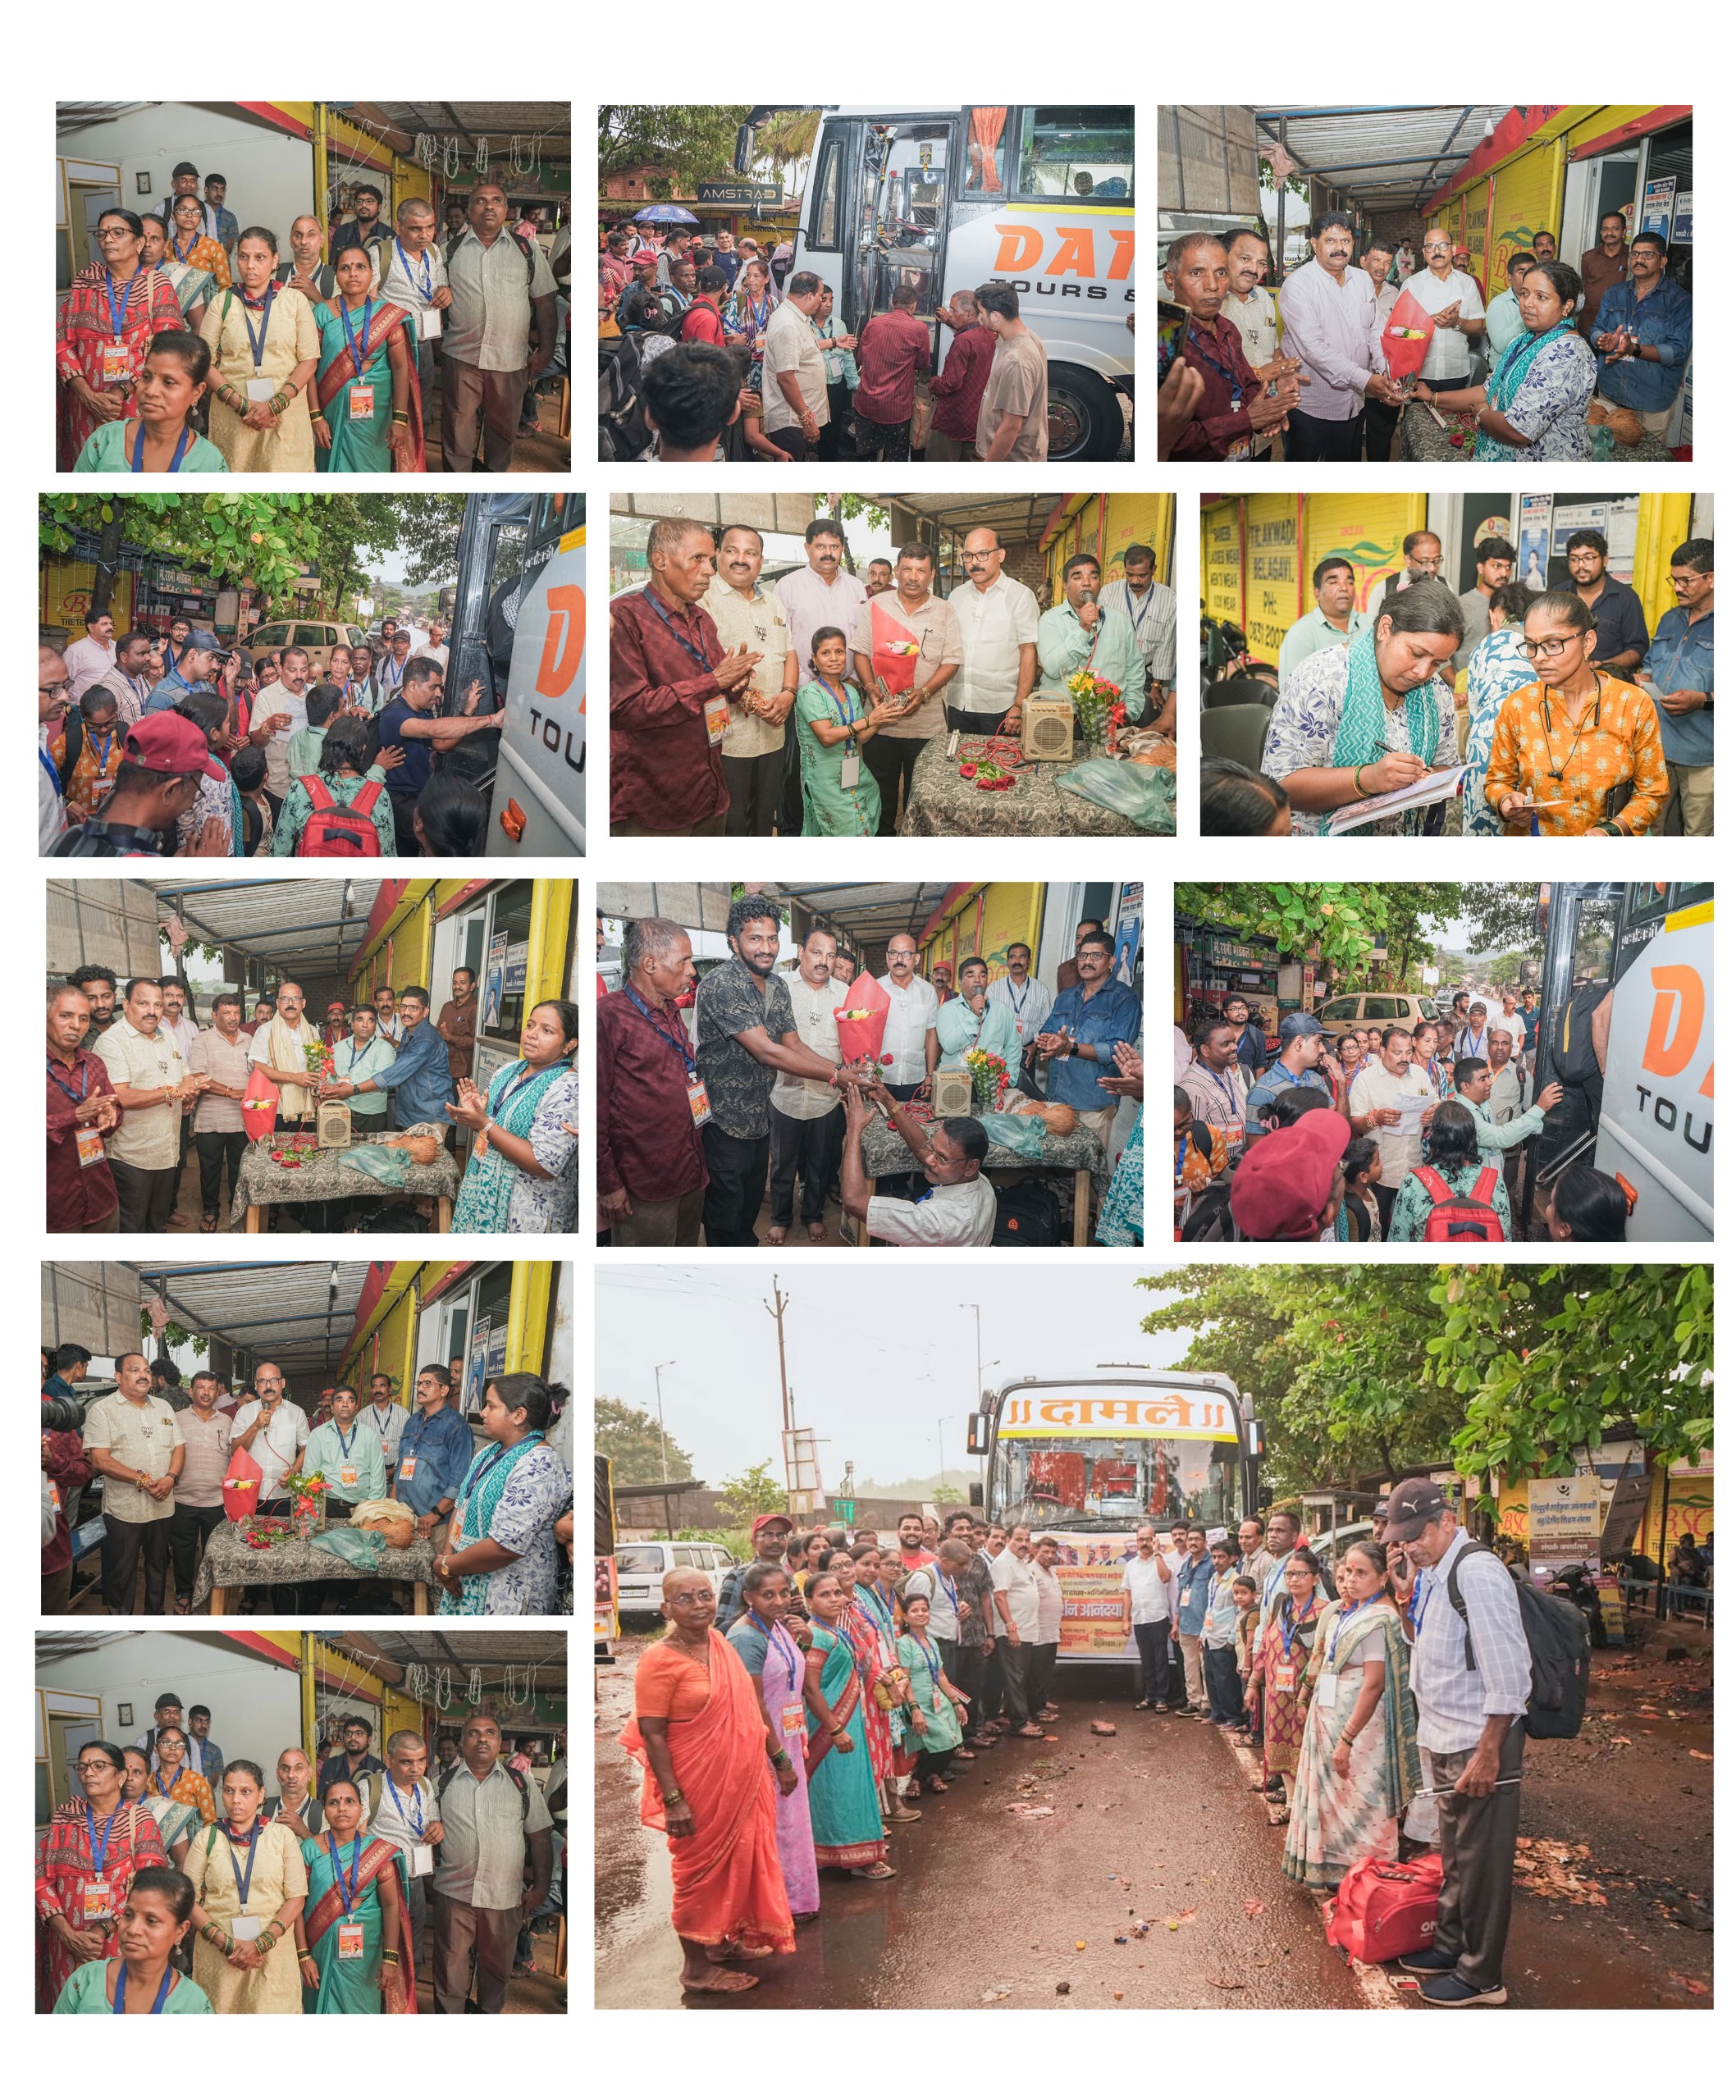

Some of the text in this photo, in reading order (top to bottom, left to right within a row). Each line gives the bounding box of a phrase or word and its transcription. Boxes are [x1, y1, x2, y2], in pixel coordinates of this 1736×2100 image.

[702, 189, 777, 199] AMSTRAD
[989, 278, 1108, 299] TOURS
[1642, 964, 1714, 1099] D
[1039, 1394, 1194, 1427] दामले
[1501, 1513, 1529, 1533] BSC
[1080, 1600, 1123, 1617] आनंदया
